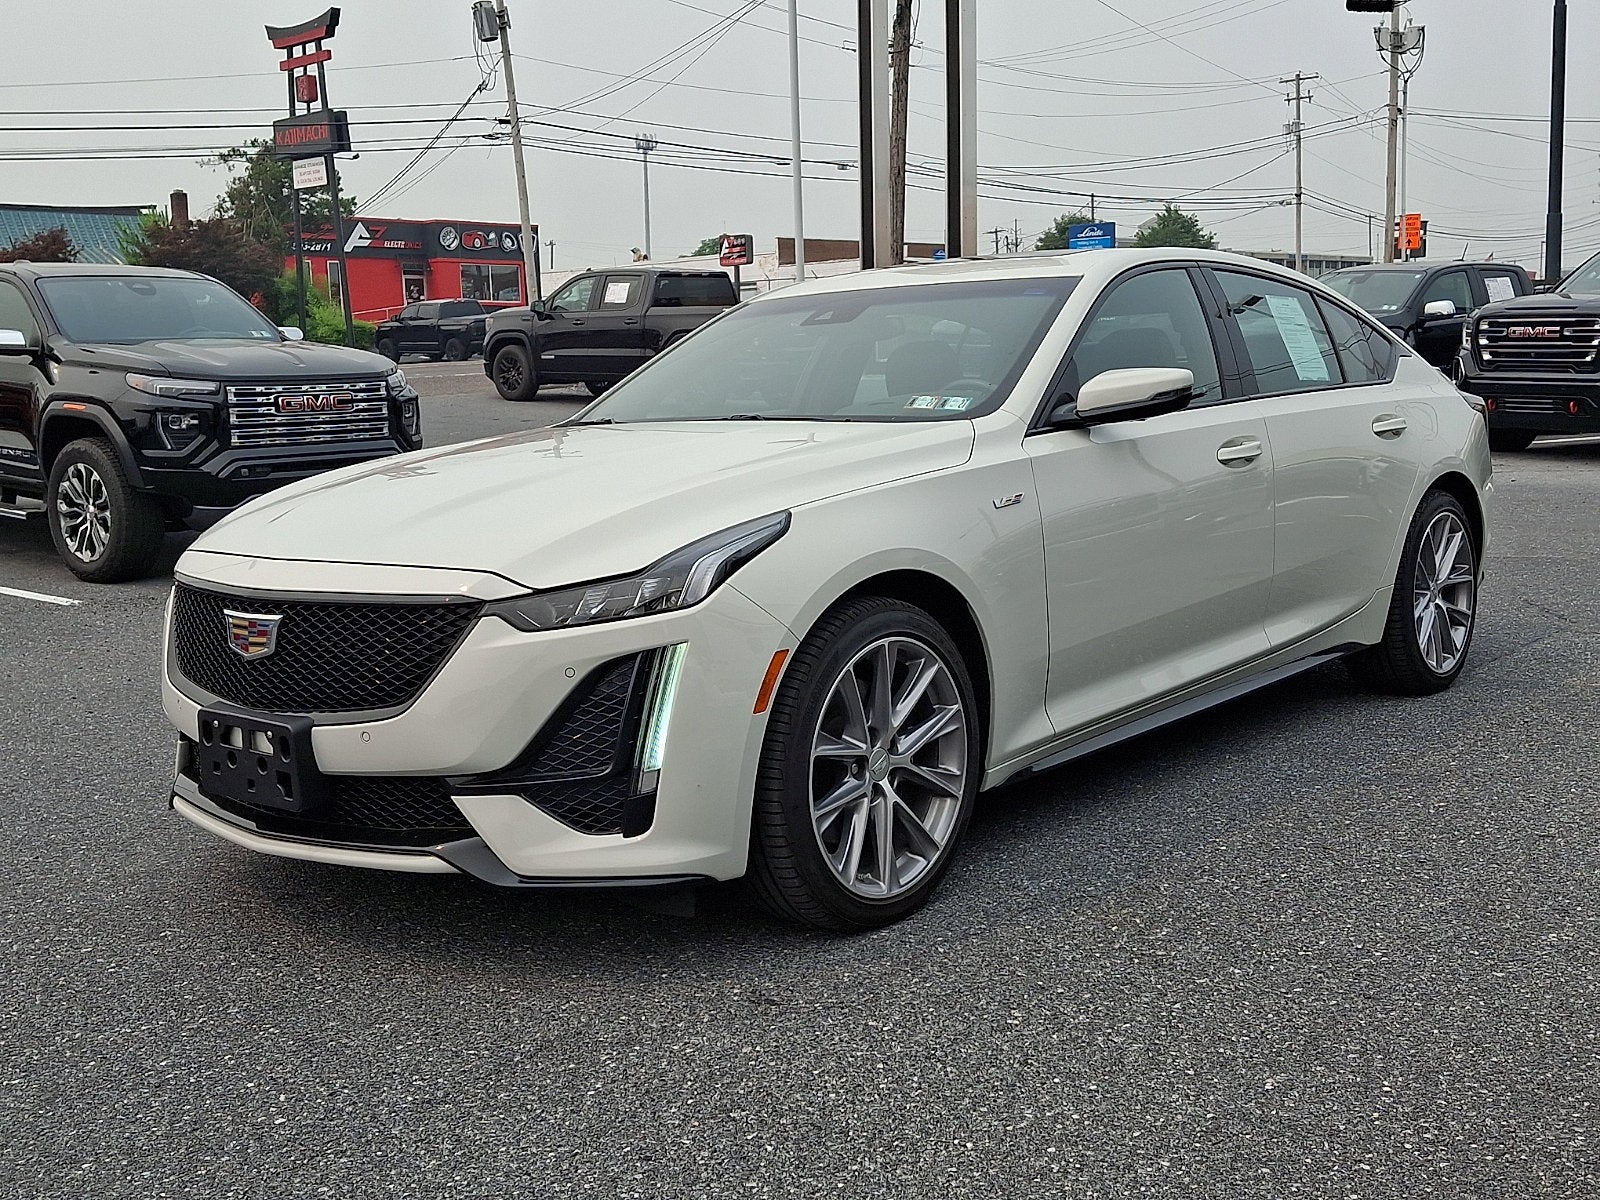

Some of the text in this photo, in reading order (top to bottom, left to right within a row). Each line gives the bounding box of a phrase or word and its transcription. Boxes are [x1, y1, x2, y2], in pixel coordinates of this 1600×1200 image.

[1077, 226, 1103, 237] Linde
[1508, 326, 1560, 338] GMC
[279, 394, 352, 412] GMC
